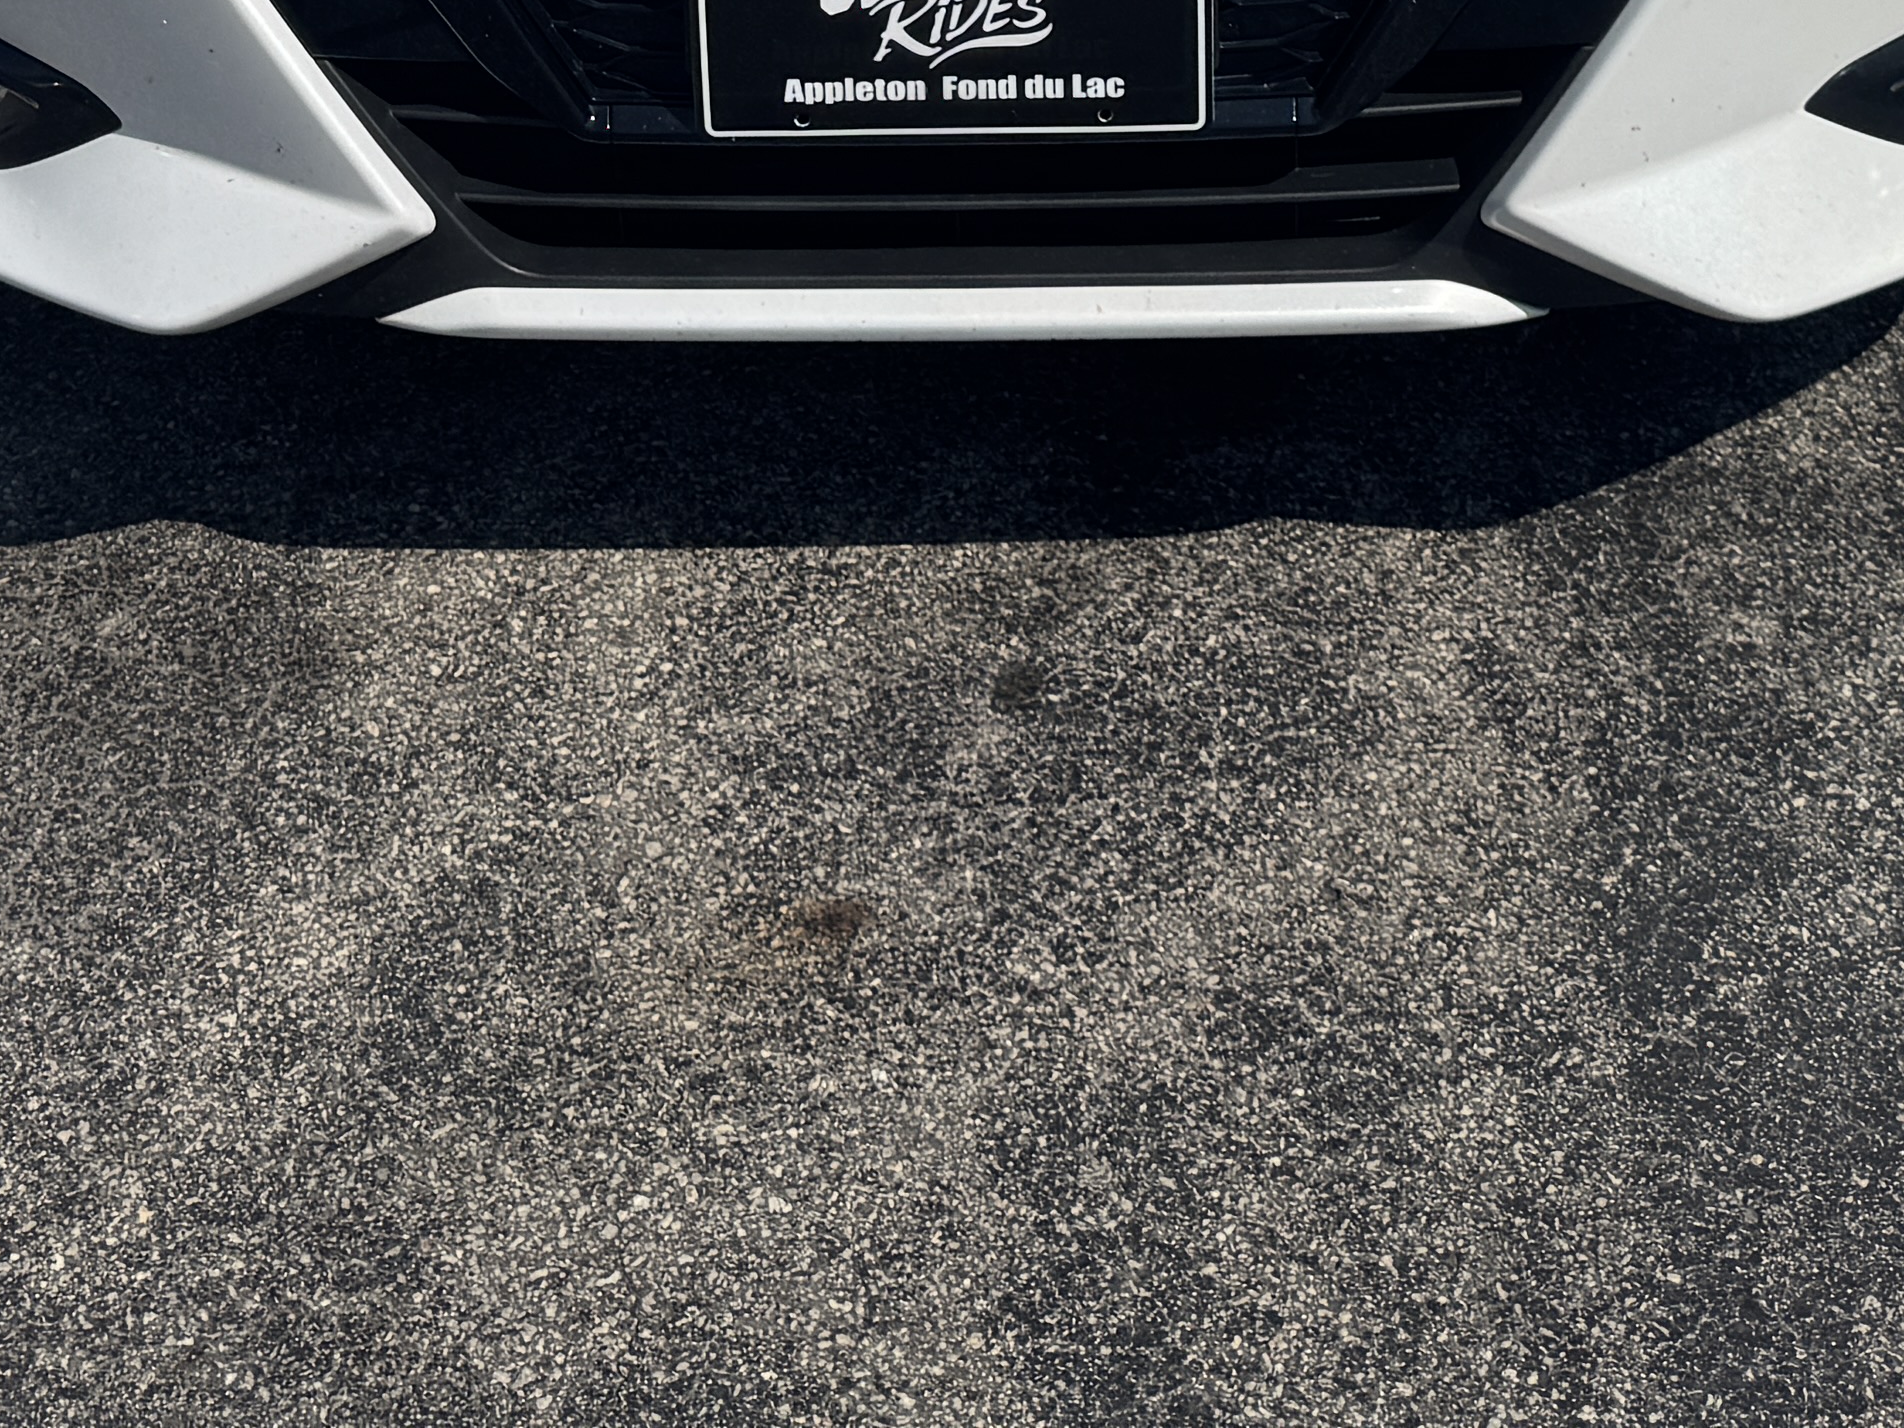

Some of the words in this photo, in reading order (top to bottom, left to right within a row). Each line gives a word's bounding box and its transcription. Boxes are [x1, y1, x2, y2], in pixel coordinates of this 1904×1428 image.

[783, 77, 927, 105] Appleton
[942, 75, 1017, 101] Fond
[1024, 74, 1065, 100] du
[1072, 73, 1126, 100] Lac
